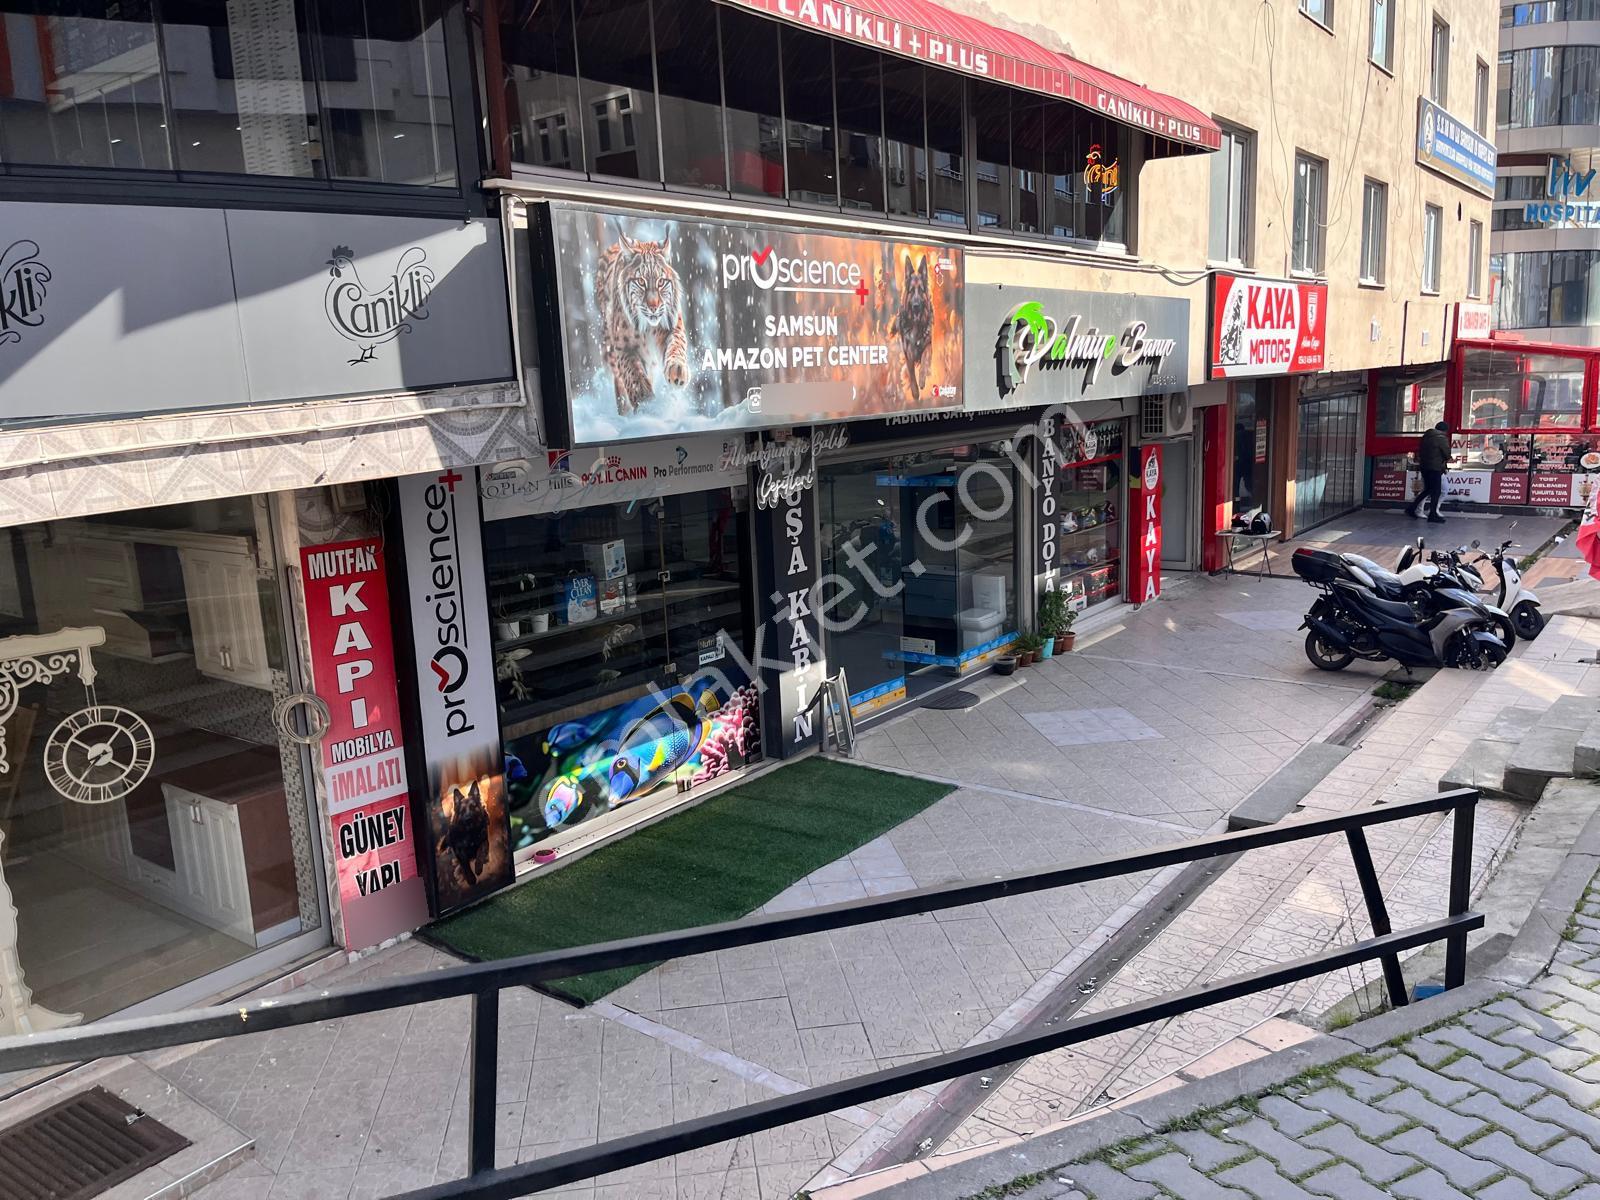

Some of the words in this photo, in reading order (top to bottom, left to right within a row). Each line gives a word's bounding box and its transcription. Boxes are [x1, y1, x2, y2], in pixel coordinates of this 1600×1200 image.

[929, 38, 988, 74] PLUS
[1168, 119, 1201, 141] PLUS
[1246, 284, 1296, 329] KAYA
[764, 315, 838, 337] SAMSUN
[701, 348, 788, 371] AMAZON
[792, 346, 821, 368] PET
[828, 346, 888, 366] CENTER
[1019, 314, 1117, 385] Palmiye
[1120, 320, 1176, 374] Banyo
[1249, 339, 1291, 365] MOTORS
[653, 467, 667, 478] Pro
[668, 462, 714, 476] Performance
[1042, 418, 1057, 517] BANYO
[307, 545, 378, 580] MUTFAK
[1145, 494, 1159, 600] KAYA
[328, 580, 375, 729] KAPI
[339, 806, 405, 860] GÜNEY
